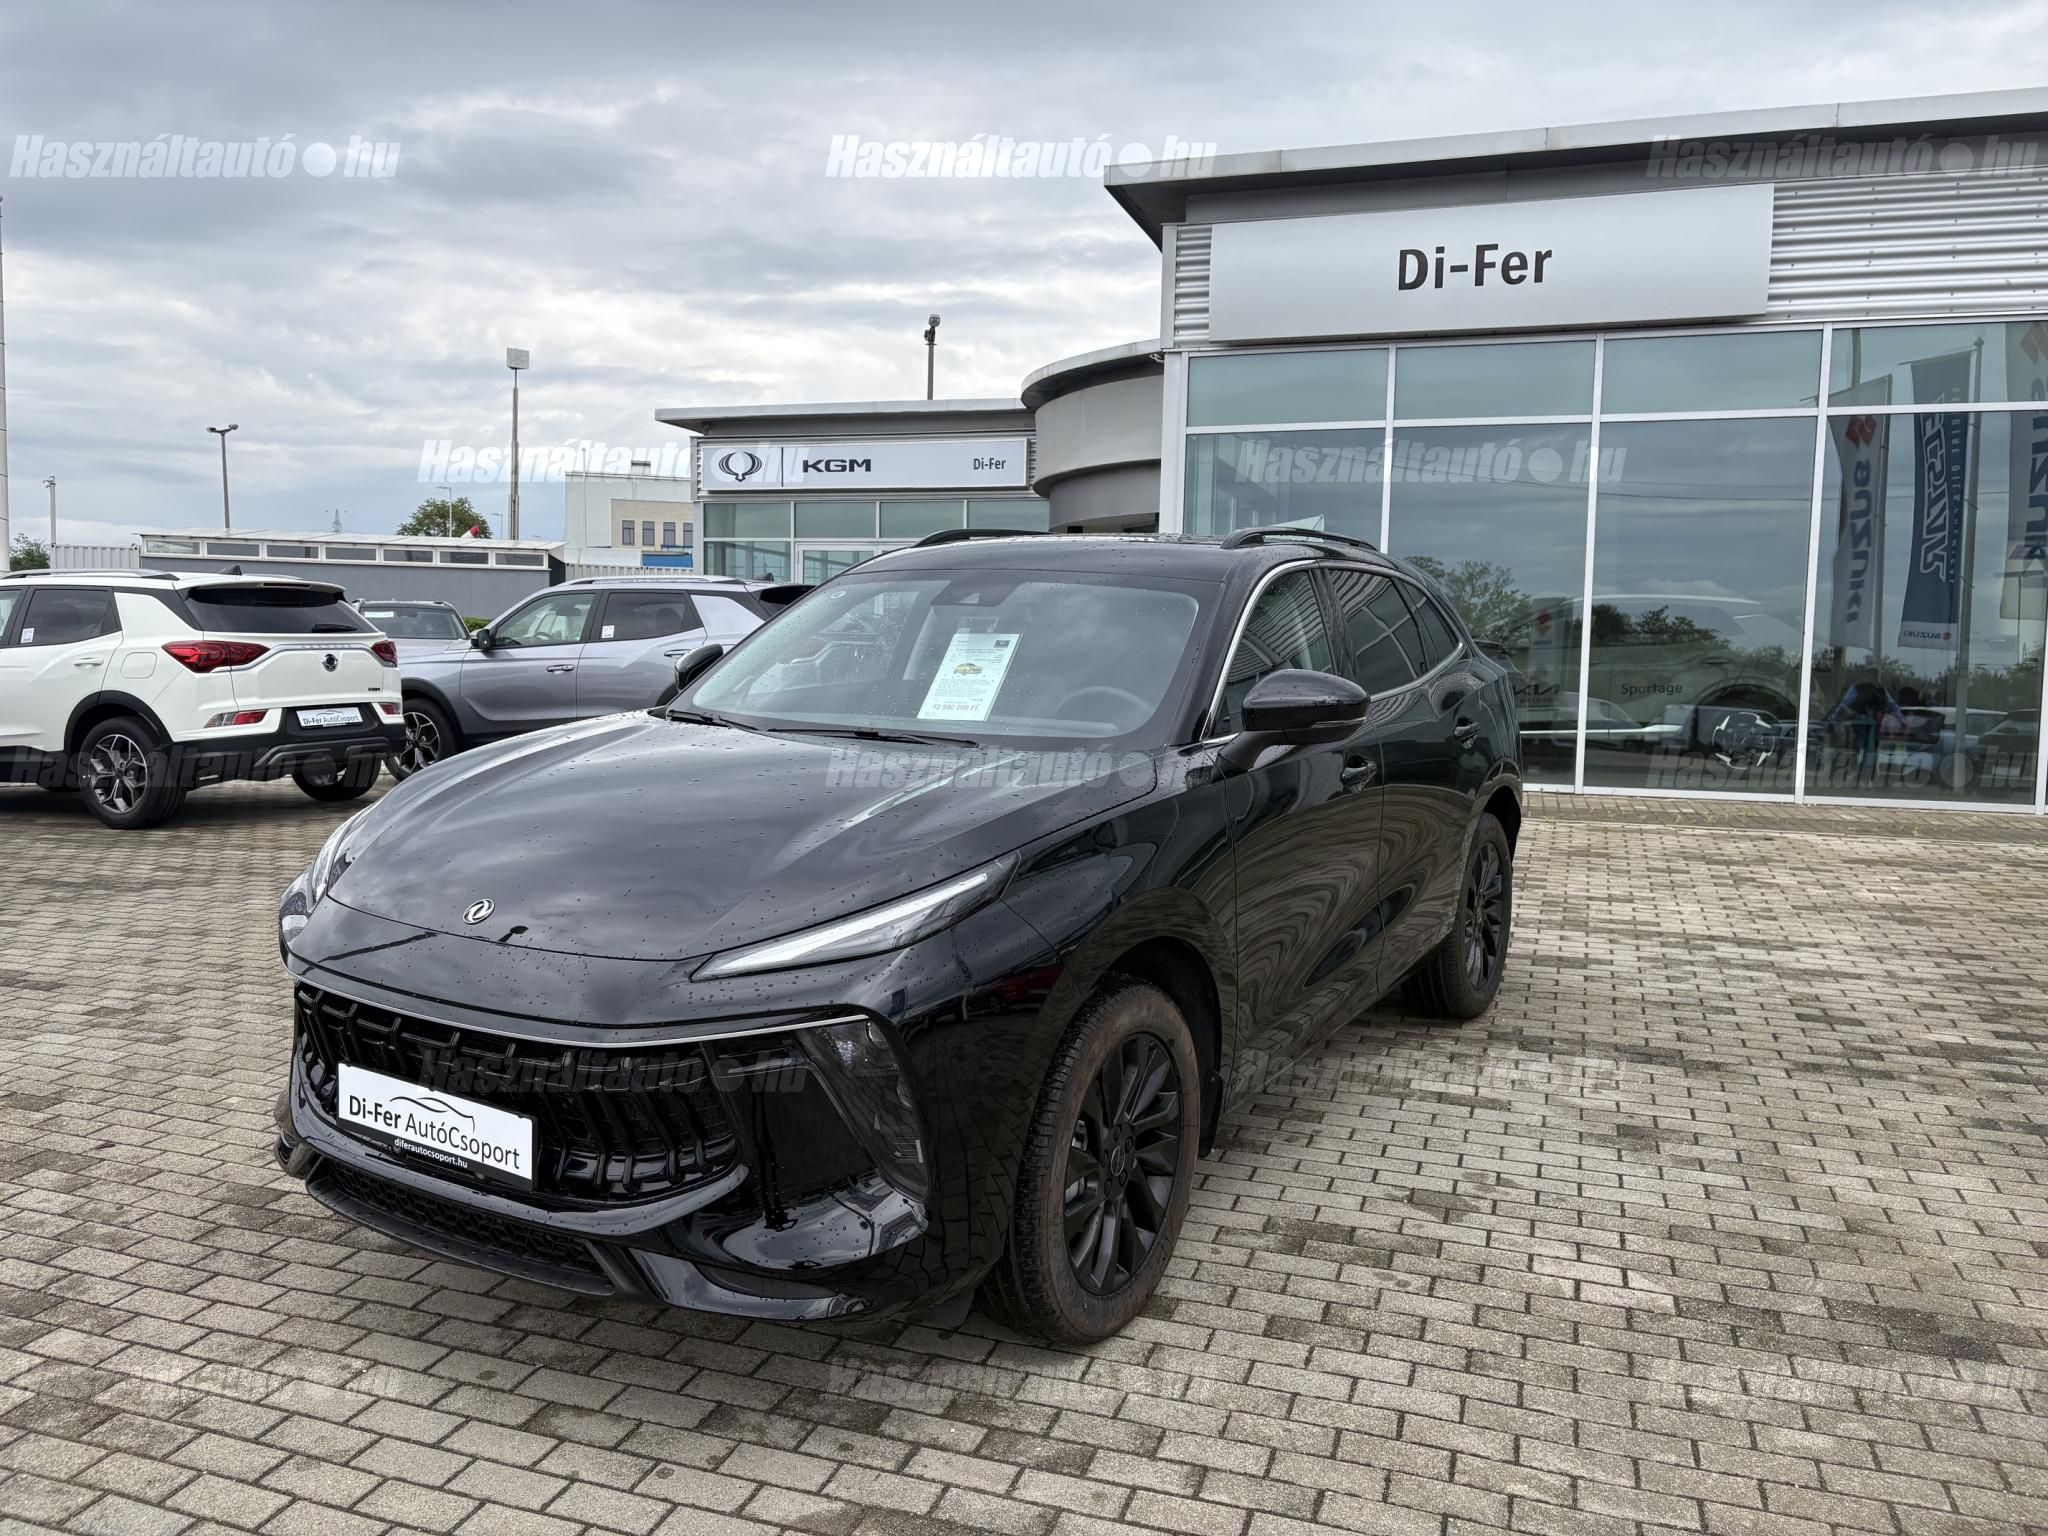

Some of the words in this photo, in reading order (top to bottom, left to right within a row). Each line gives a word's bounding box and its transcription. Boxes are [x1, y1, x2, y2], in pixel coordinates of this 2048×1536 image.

[1397, 243, 1553, 291] Di-Fer
[802, 458, 872, 473] KGM
[973, 457, 1007, 471] Di-Fer
[1621, 682, 1683, 696] Sportage
[349, 1094, 402, 1130] Di-Fer
[404, 1112, 520, 1170] AutóCsoport
[394, 1137, 469, 1169] diferautocsoport.hu
